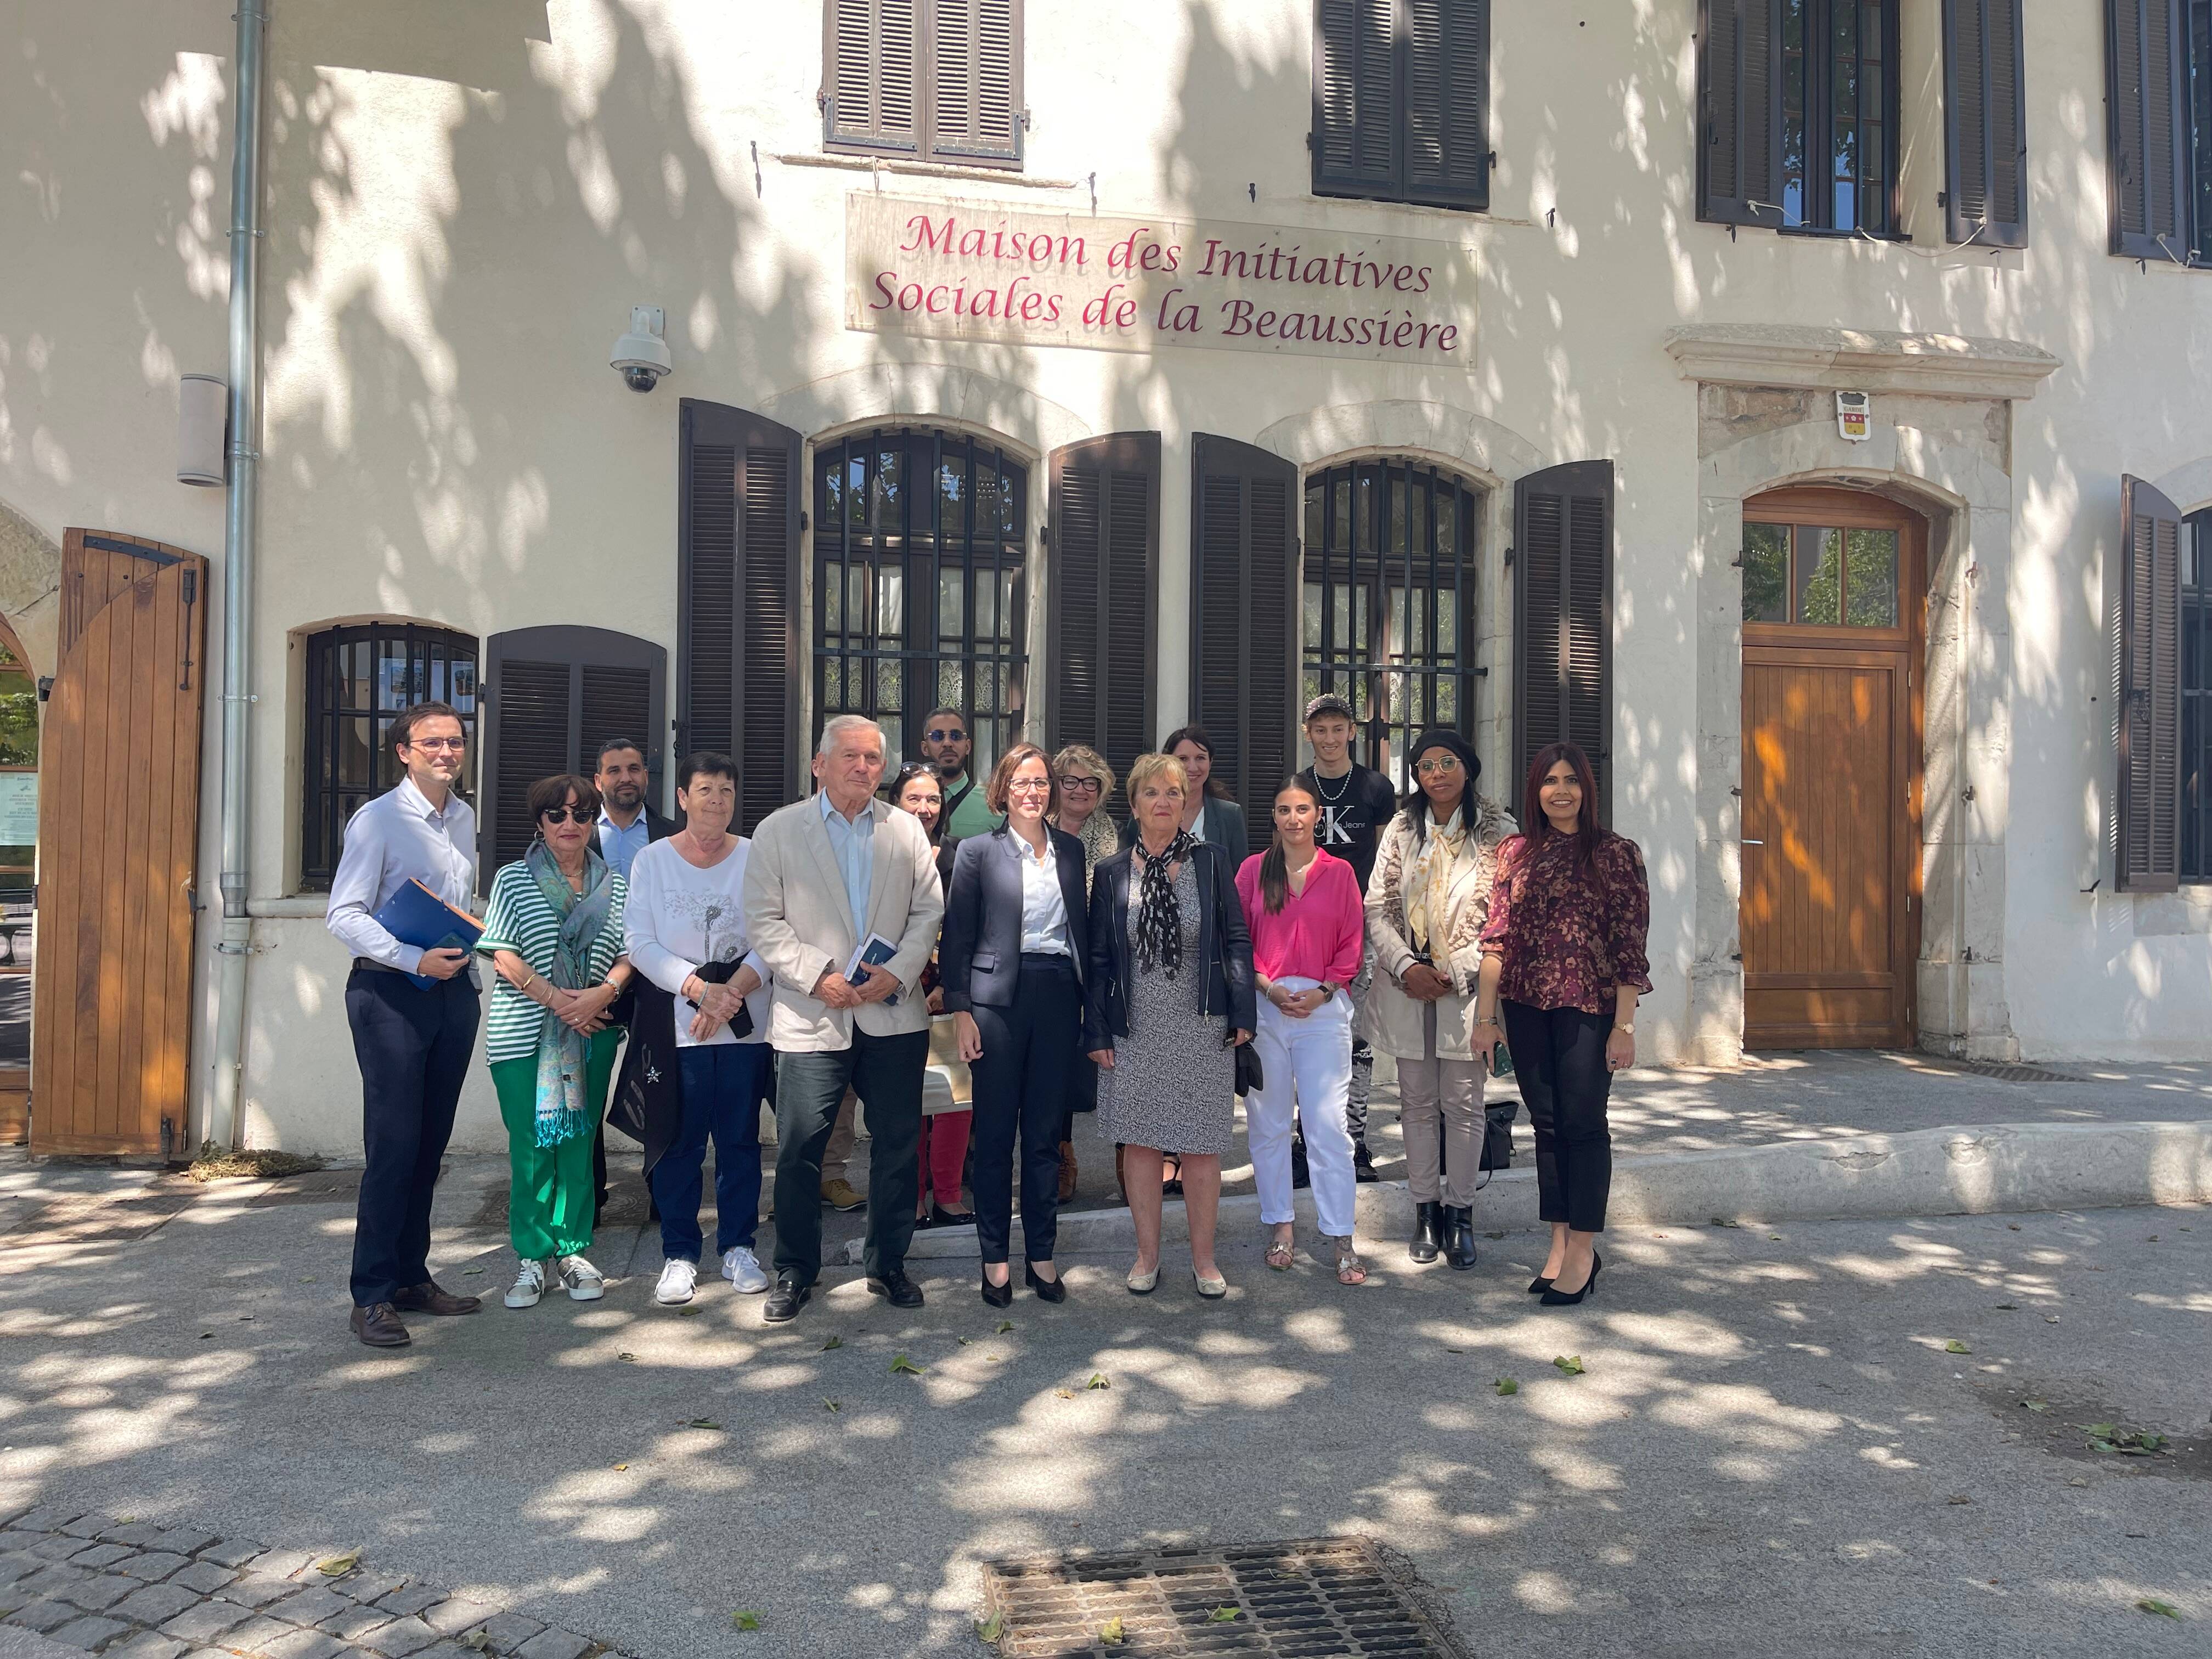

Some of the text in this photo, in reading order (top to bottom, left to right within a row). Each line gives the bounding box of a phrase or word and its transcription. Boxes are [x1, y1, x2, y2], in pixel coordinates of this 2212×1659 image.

[899, 215, 1432, 293] Maison des Initiatives
[868, 271, 1458, 352] Sociales de la Beaussière
[1343, 821, 1365, 829] Jeans
